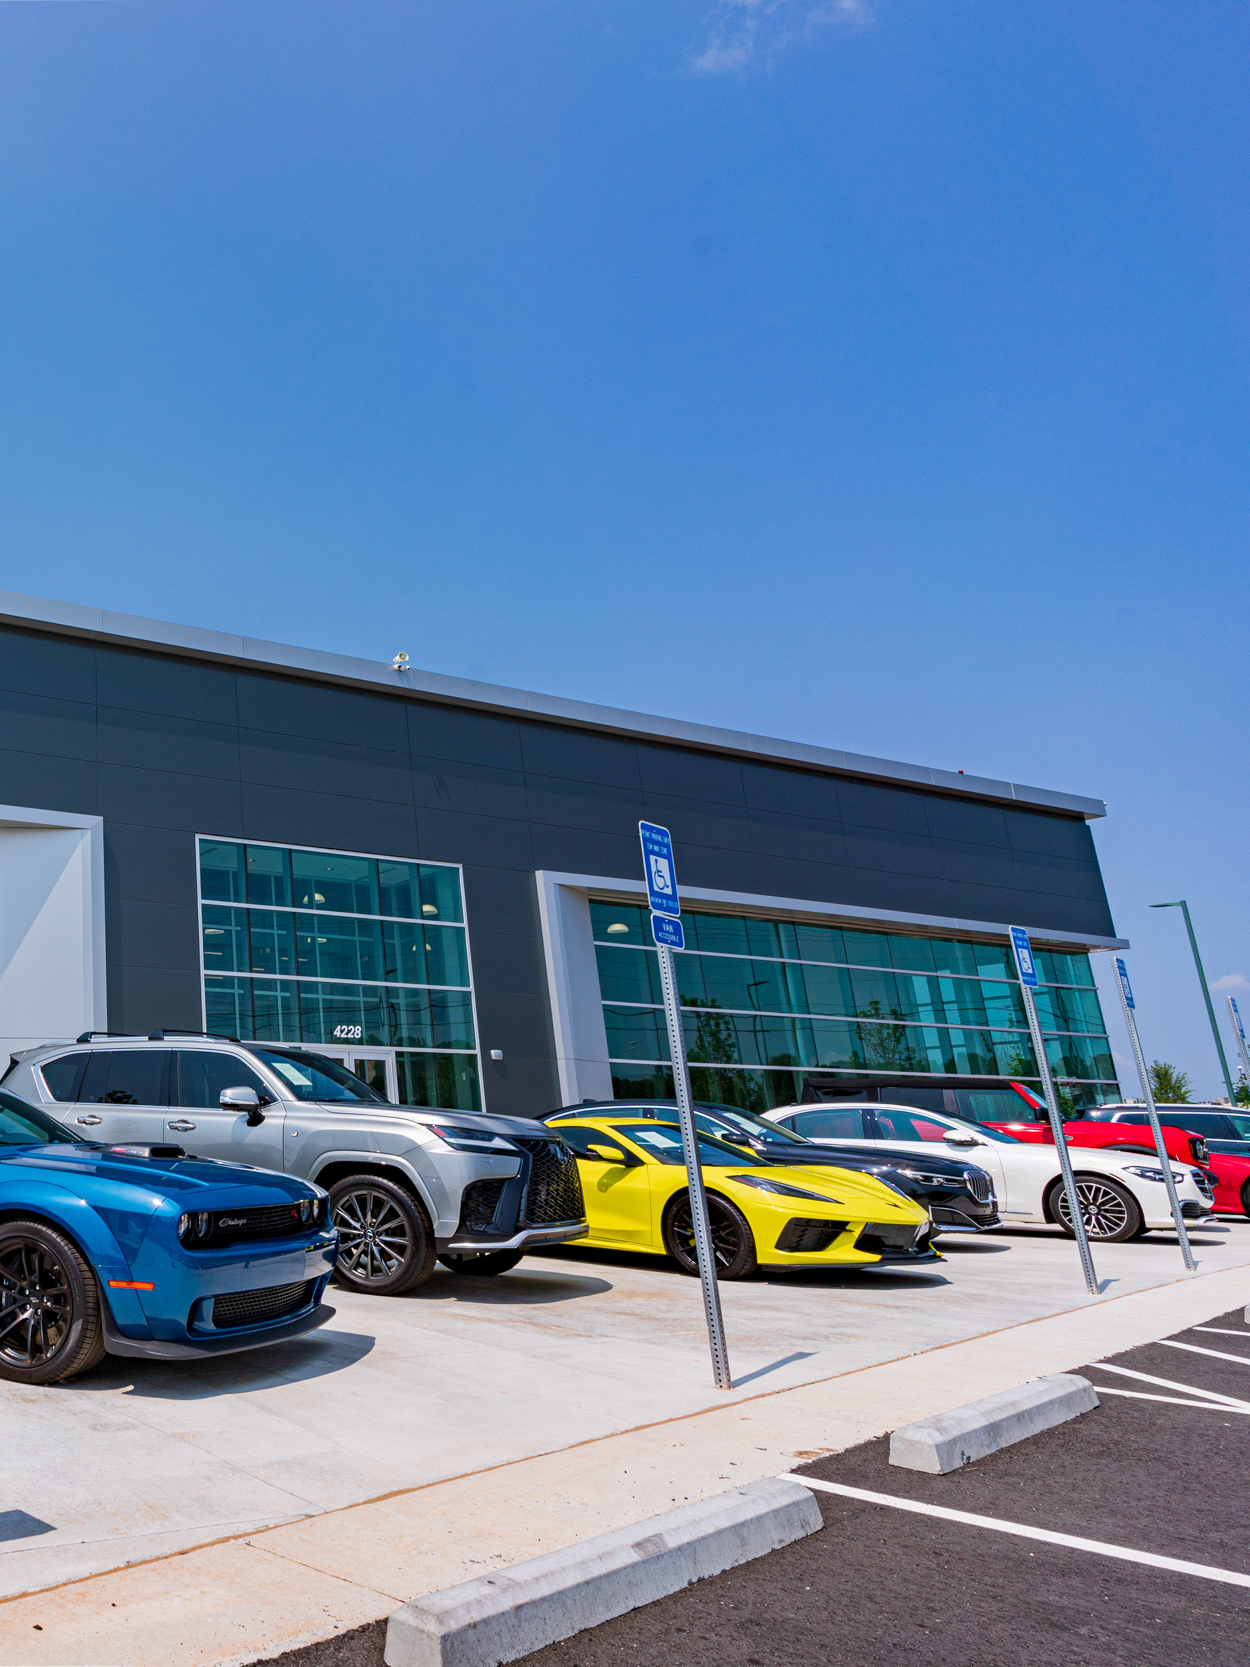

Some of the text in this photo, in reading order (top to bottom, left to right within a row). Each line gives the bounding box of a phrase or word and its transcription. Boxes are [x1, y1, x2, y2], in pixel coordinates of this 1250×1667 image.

[662, 922, 673, 933] VAN
[658, 932, 679, 942] ACCESSIBLE
[333, 1025, 362, 1038] 4228
